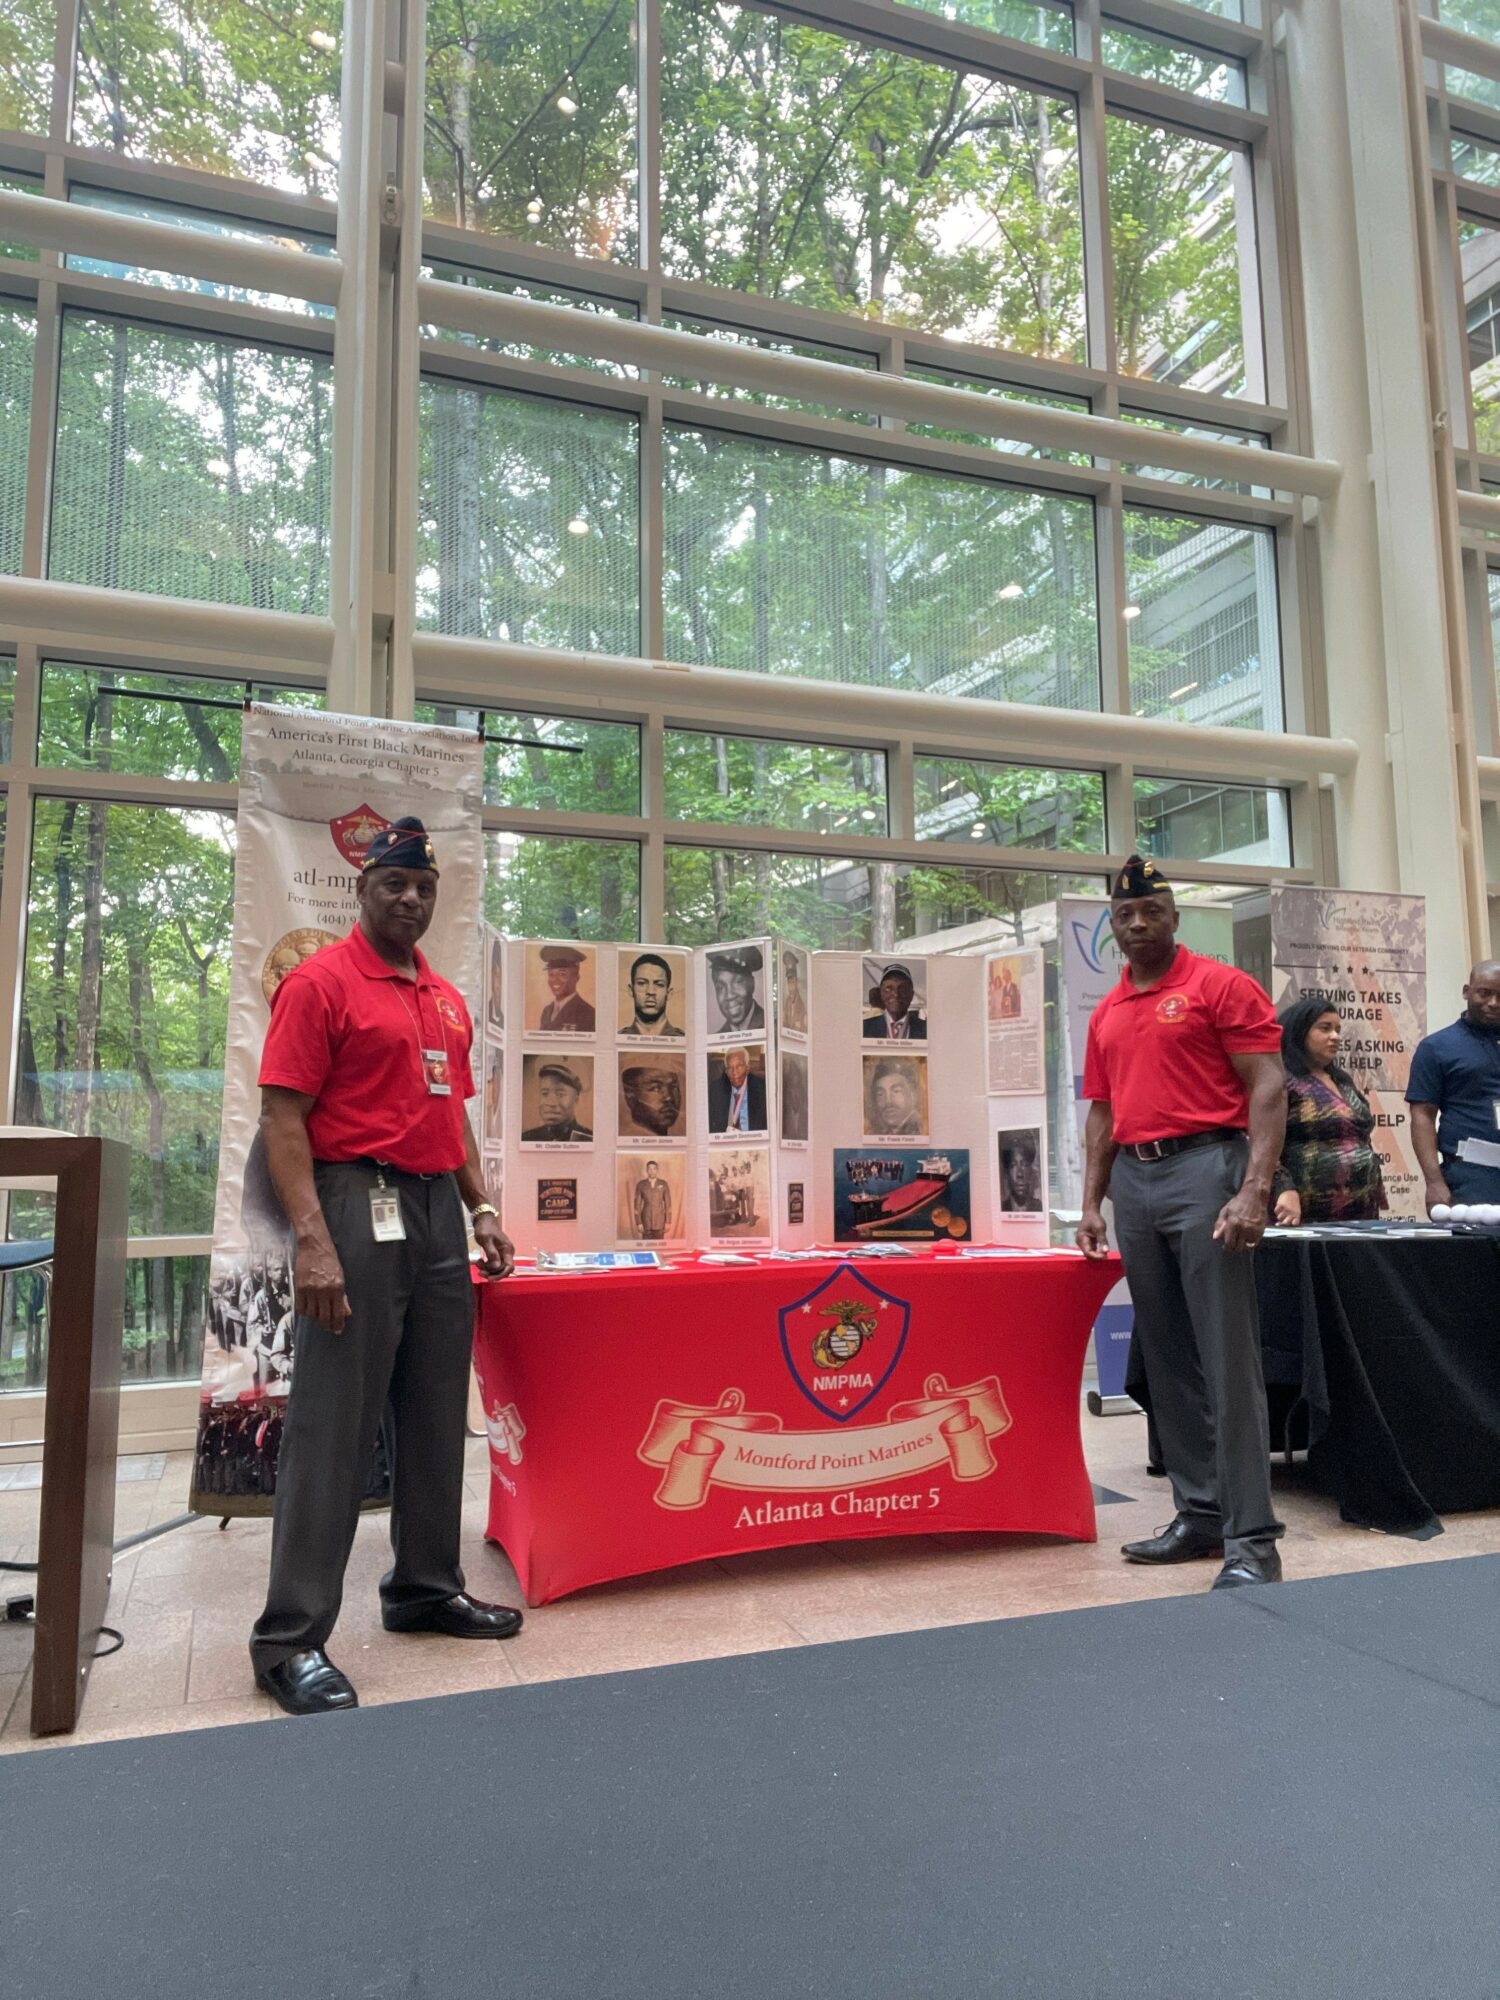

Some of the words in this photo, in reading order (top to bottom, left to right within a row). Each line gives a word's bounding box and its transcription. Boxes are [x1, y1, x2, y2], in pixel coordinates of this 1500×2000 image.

[266, 727, 333, 744] America's
[338, 733, 368, 748] First
[372, 738, 409, 754] Black
[412, 744, 465, 763] Marines
[292, 749, 336, 764] Atlanta,
[340, 754, 384, 769] Georgia
[387, 760, 430, 777] Chapter
[433, 768, 440, 776] 5
[293, 868, 357, 894] atl-mp
[288, 892, 304, 904] For
[308, 899, 338, 910] more
[317, 913, 346, 927] (404)
[1300, 988, 1356, 1003] SERVING
[1360, 991, 1402, 1004] TAKES
[1339, 1007, 1383, 1021] URAGE
[1355, 1040, 1405, 1053] ASKING
[1349, 1057, 1383, 1070] HELP
[545, 1199, 569, 1208] CAMP
[813, 1373, 873, 1391] NMPMA
[734, 1446, 817, 1470] Montford
[821, 1452, 865, 1470] Point
[868, 1433, 934, 1463] Marines
[734, 1500, 824, 1528] Atlanta
[830, 1491, 922, 1518] Chapter
[928, 1487, 940, 1508] 5
